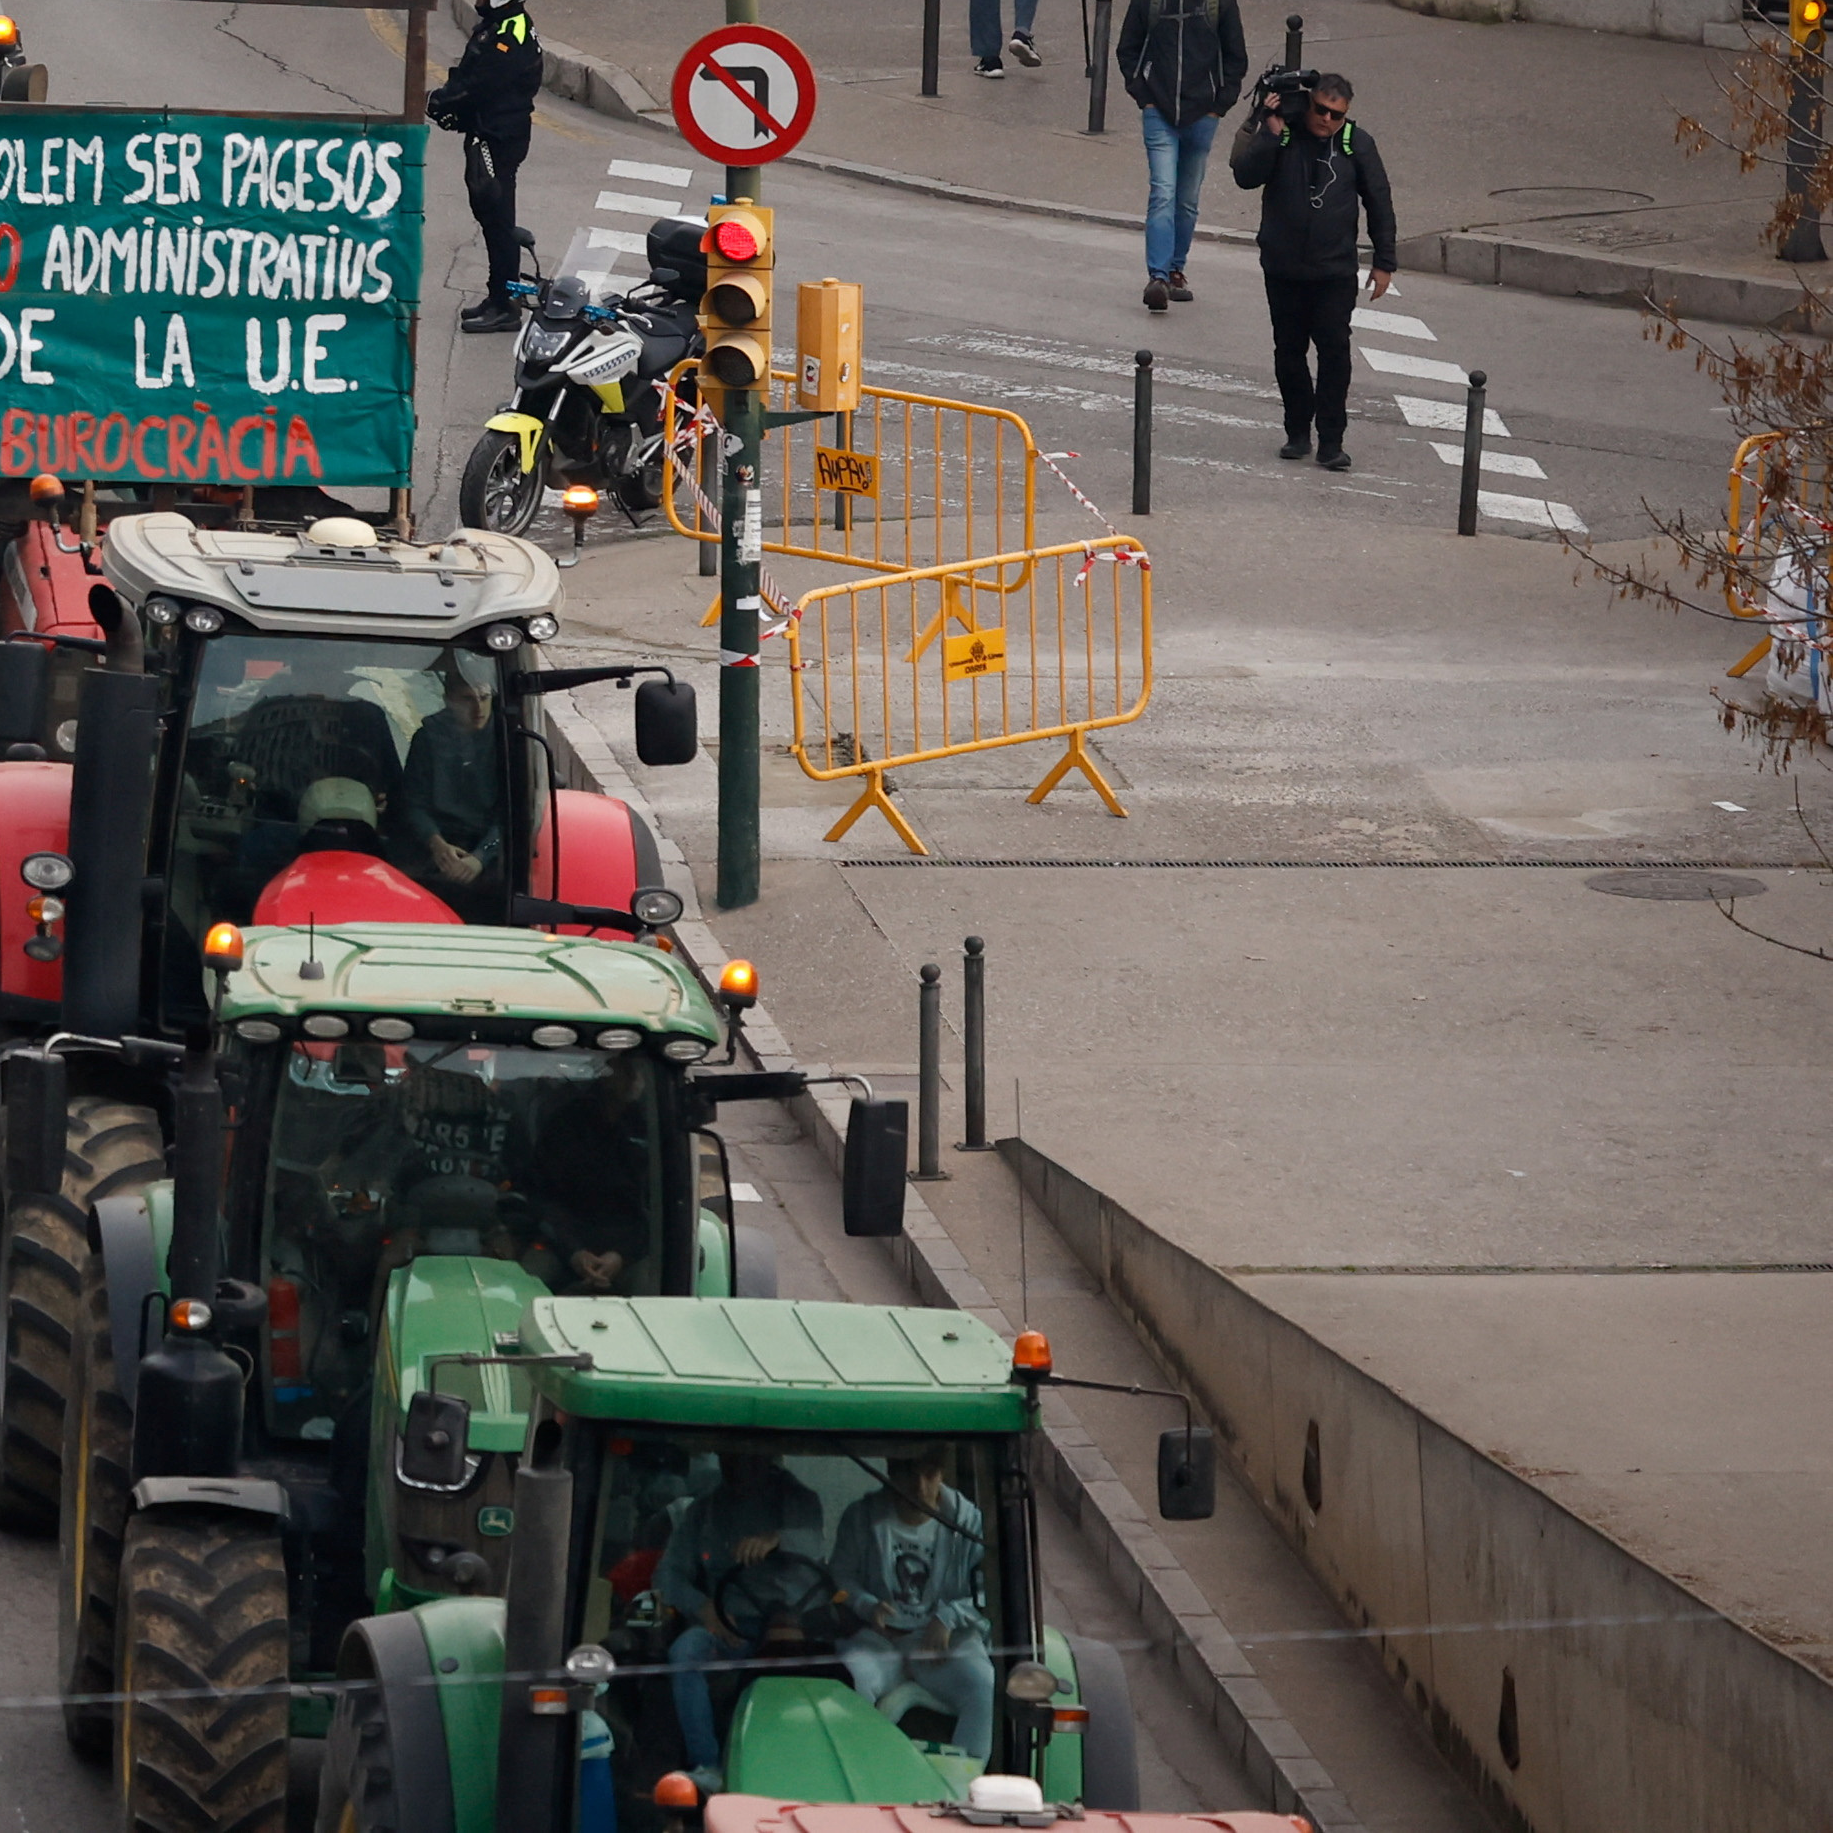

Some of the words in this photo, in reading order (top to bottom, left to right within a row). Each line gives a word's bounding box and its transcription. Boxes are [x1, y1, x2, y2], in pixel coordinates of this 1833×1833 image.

[122, 132, 203, 206] SER
[221, 131, 405, 220] PAGESOS
[133, 312, 196, 389] LA
[246, 313, 359, 395] U.E.
